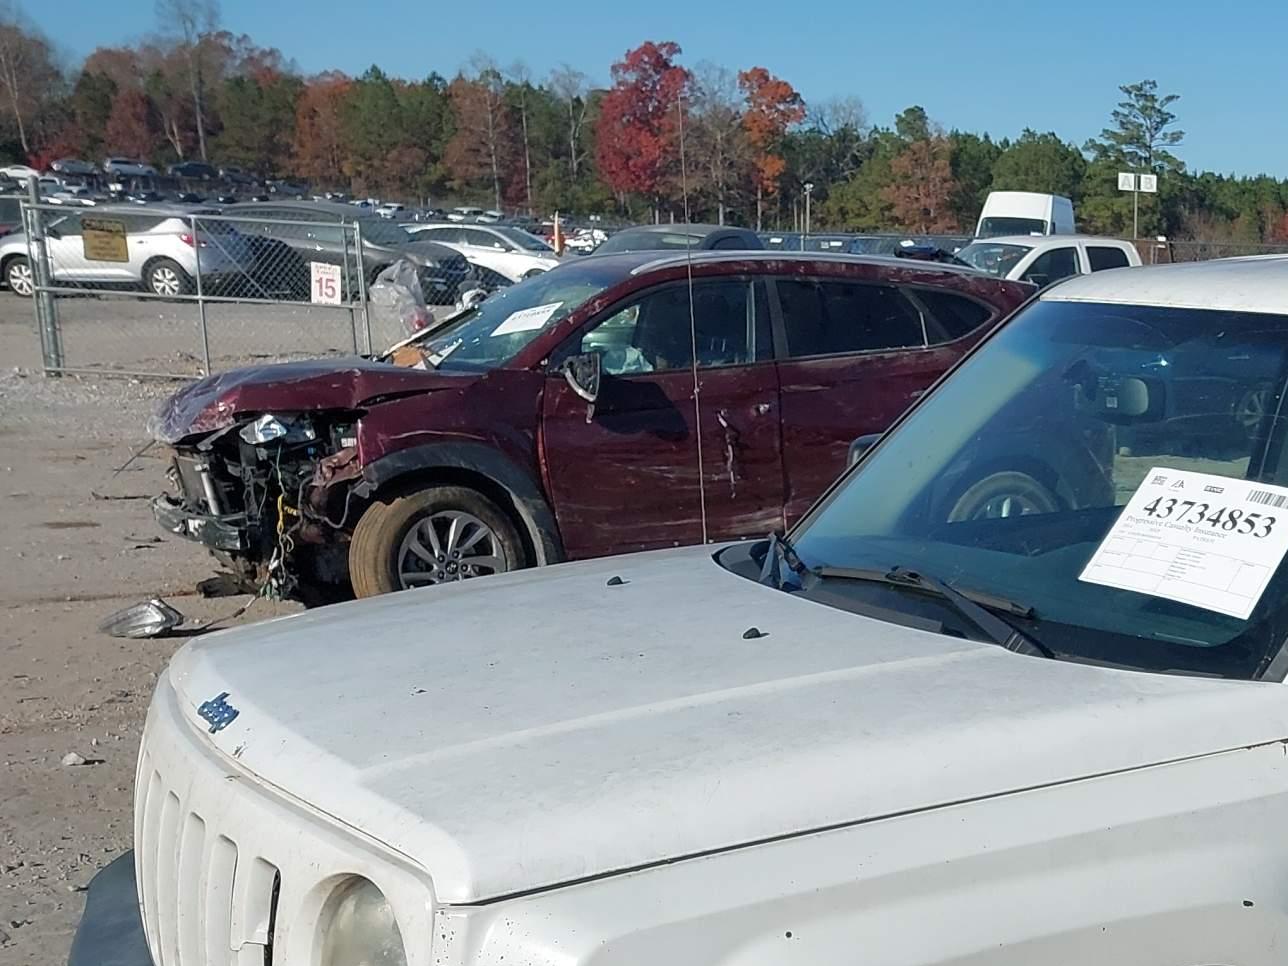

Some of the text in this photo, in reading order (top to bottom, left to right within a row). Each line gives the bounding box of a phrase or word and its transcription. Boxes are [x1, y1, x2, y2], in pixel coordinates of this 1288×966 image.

[1121, 175, 1132, 189] A
[1142, 176, 1154, 190] B
[315, 277, 336, 299] 15
[1143, 496, 1277, 538] 43734853
